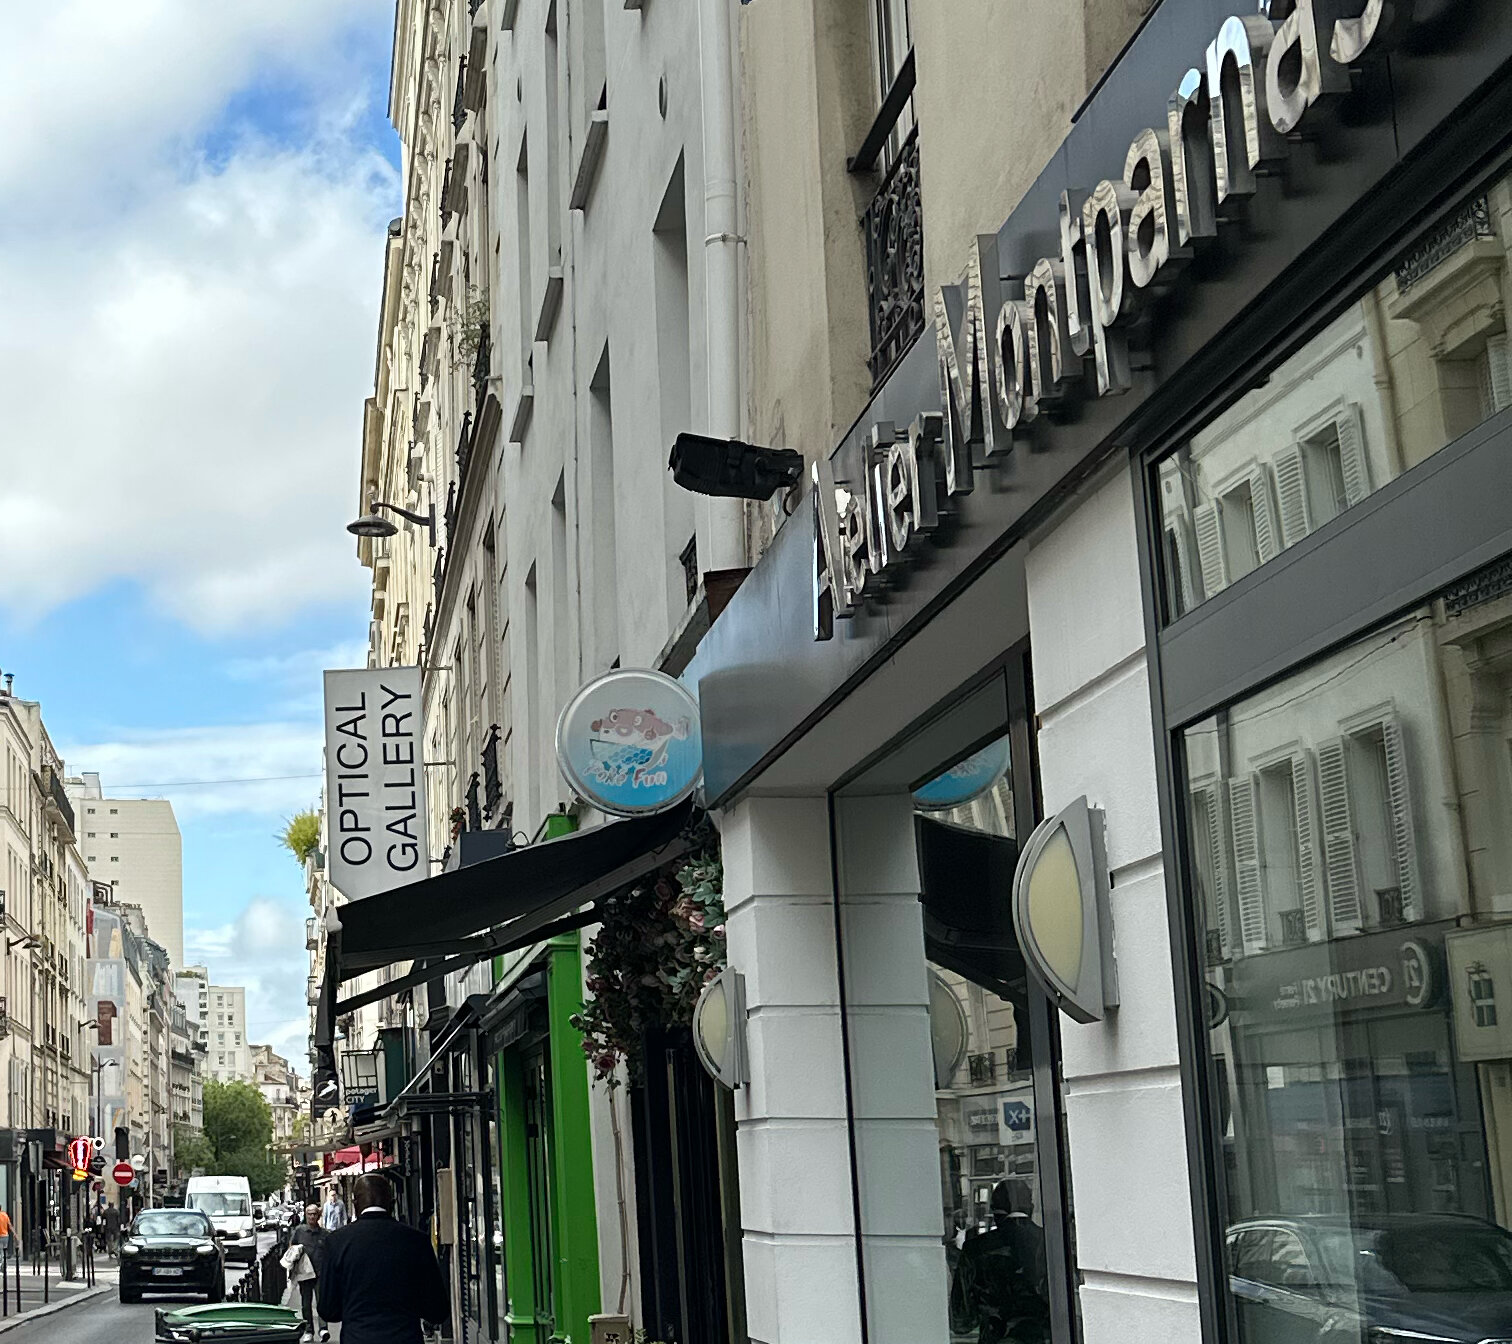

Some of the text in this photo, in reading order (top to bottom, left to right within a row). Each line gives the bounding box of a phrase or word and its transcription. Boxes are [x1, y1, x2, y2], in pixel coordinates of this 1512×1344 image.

[335, 692, 373, 866] OPTICAL
[380, 684, 419, 872] GALLERY
[632, 767, 667, 789] Fun
[345, 1095, 365, 1104] CITY
